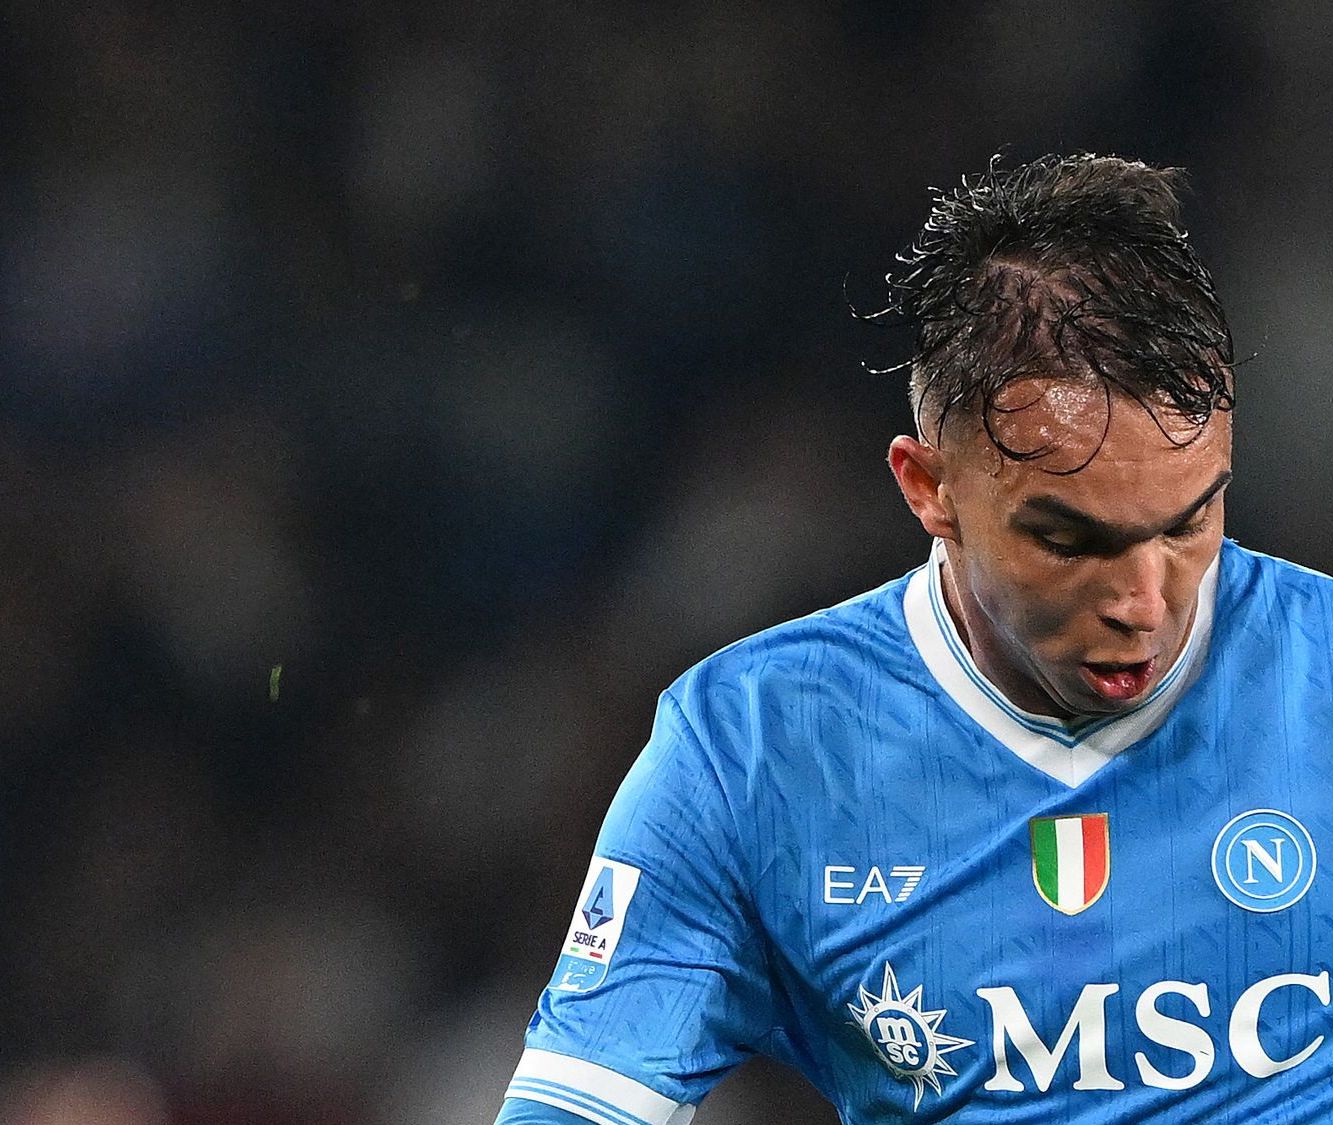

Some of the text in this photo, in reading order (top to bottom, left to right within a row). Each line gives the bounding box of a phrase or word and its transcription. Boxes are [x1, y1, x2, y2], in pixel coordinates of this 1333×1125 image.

[1240, 838, 1285, 884] N
[823, 865, 926, 905] EA7
[572, 930, 607, 951] SERIE A
[975, 970, 1332, 1093] MSC
